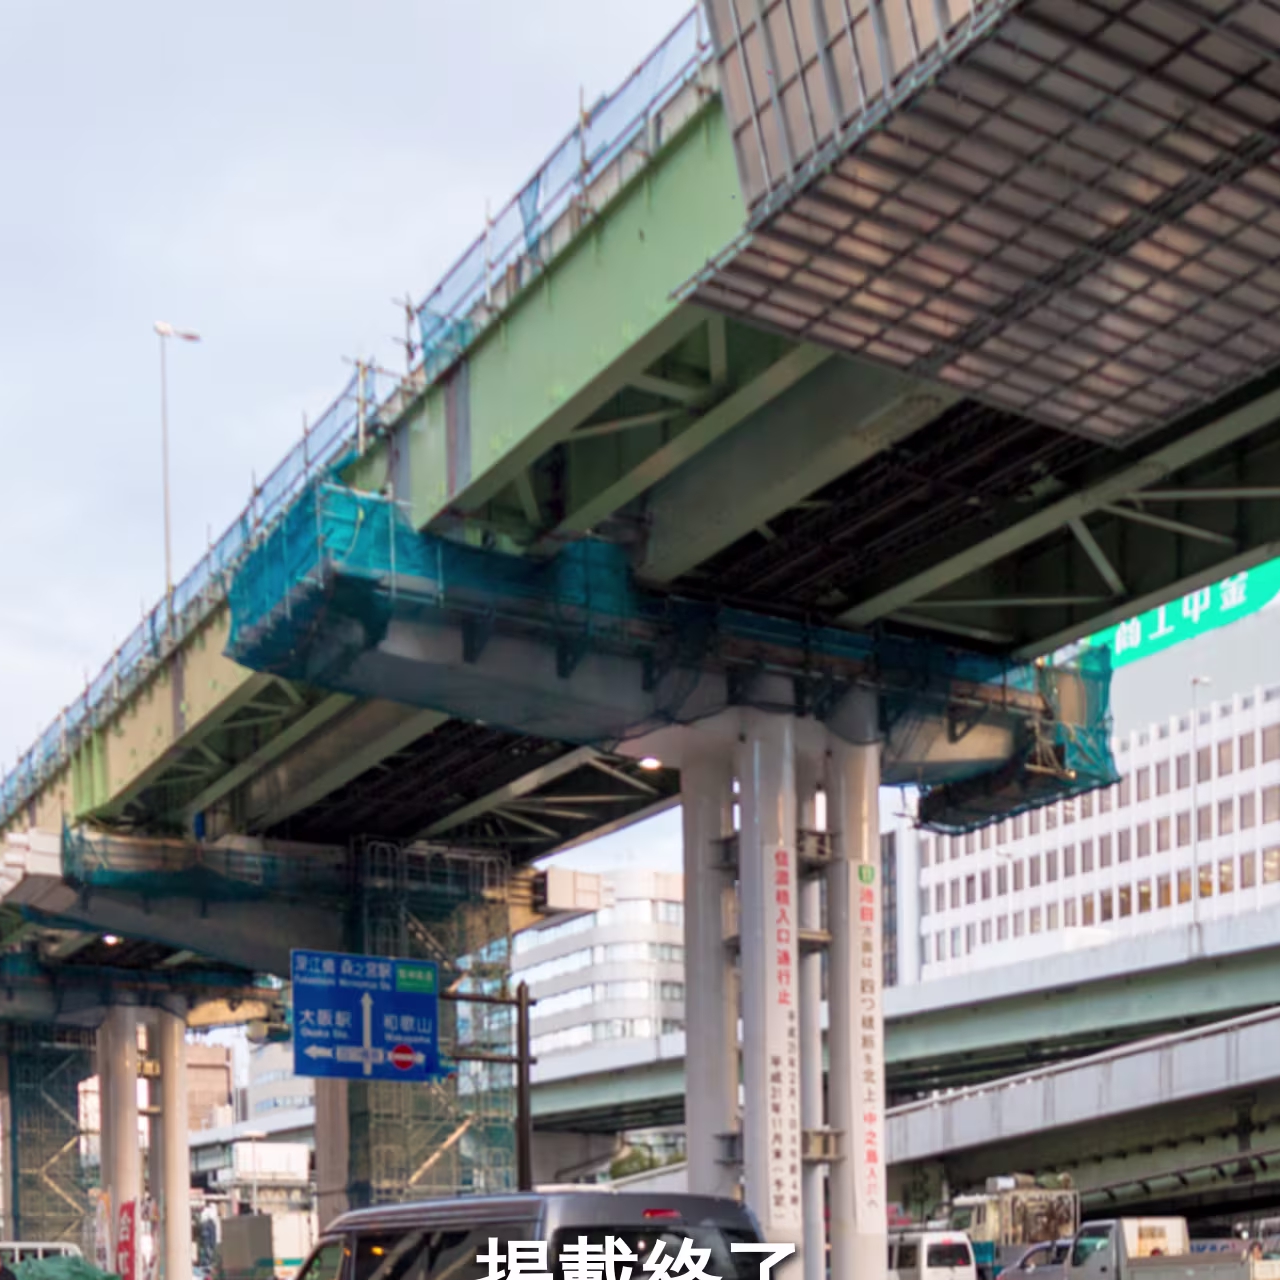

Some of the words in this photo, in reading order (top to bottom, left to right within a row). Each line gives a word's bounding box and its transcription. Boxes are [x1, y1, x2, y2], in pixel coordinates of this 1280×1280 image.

[299, 1008, 352, 1028] 大阪駅
[383, 1014, 432, 1034] 和歌山
